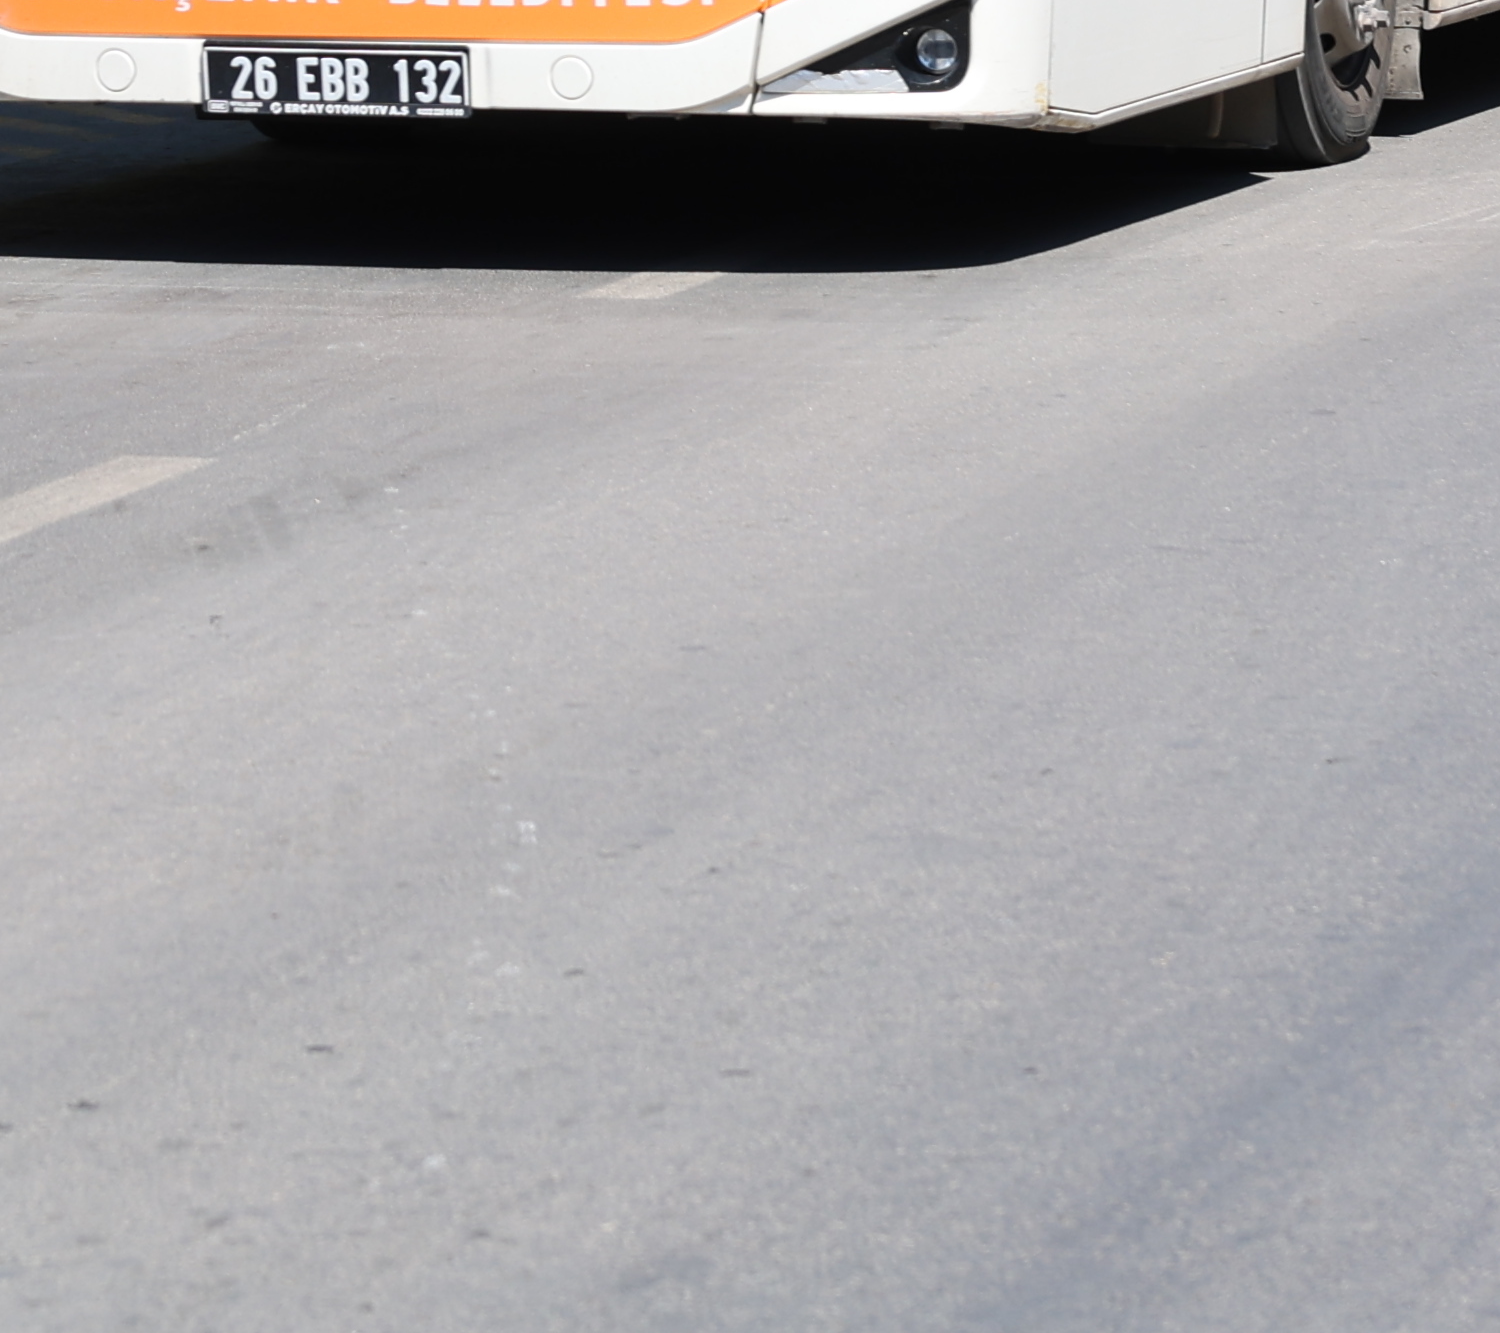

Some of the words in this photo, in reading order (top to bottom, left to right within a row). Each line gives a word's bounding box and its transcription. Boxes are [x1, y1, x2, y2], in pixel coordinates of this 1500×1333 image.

[230, 55, 278, 100] 26
[296, 56, 370, 102] EBB
[392, 58, 463, 104] 132
